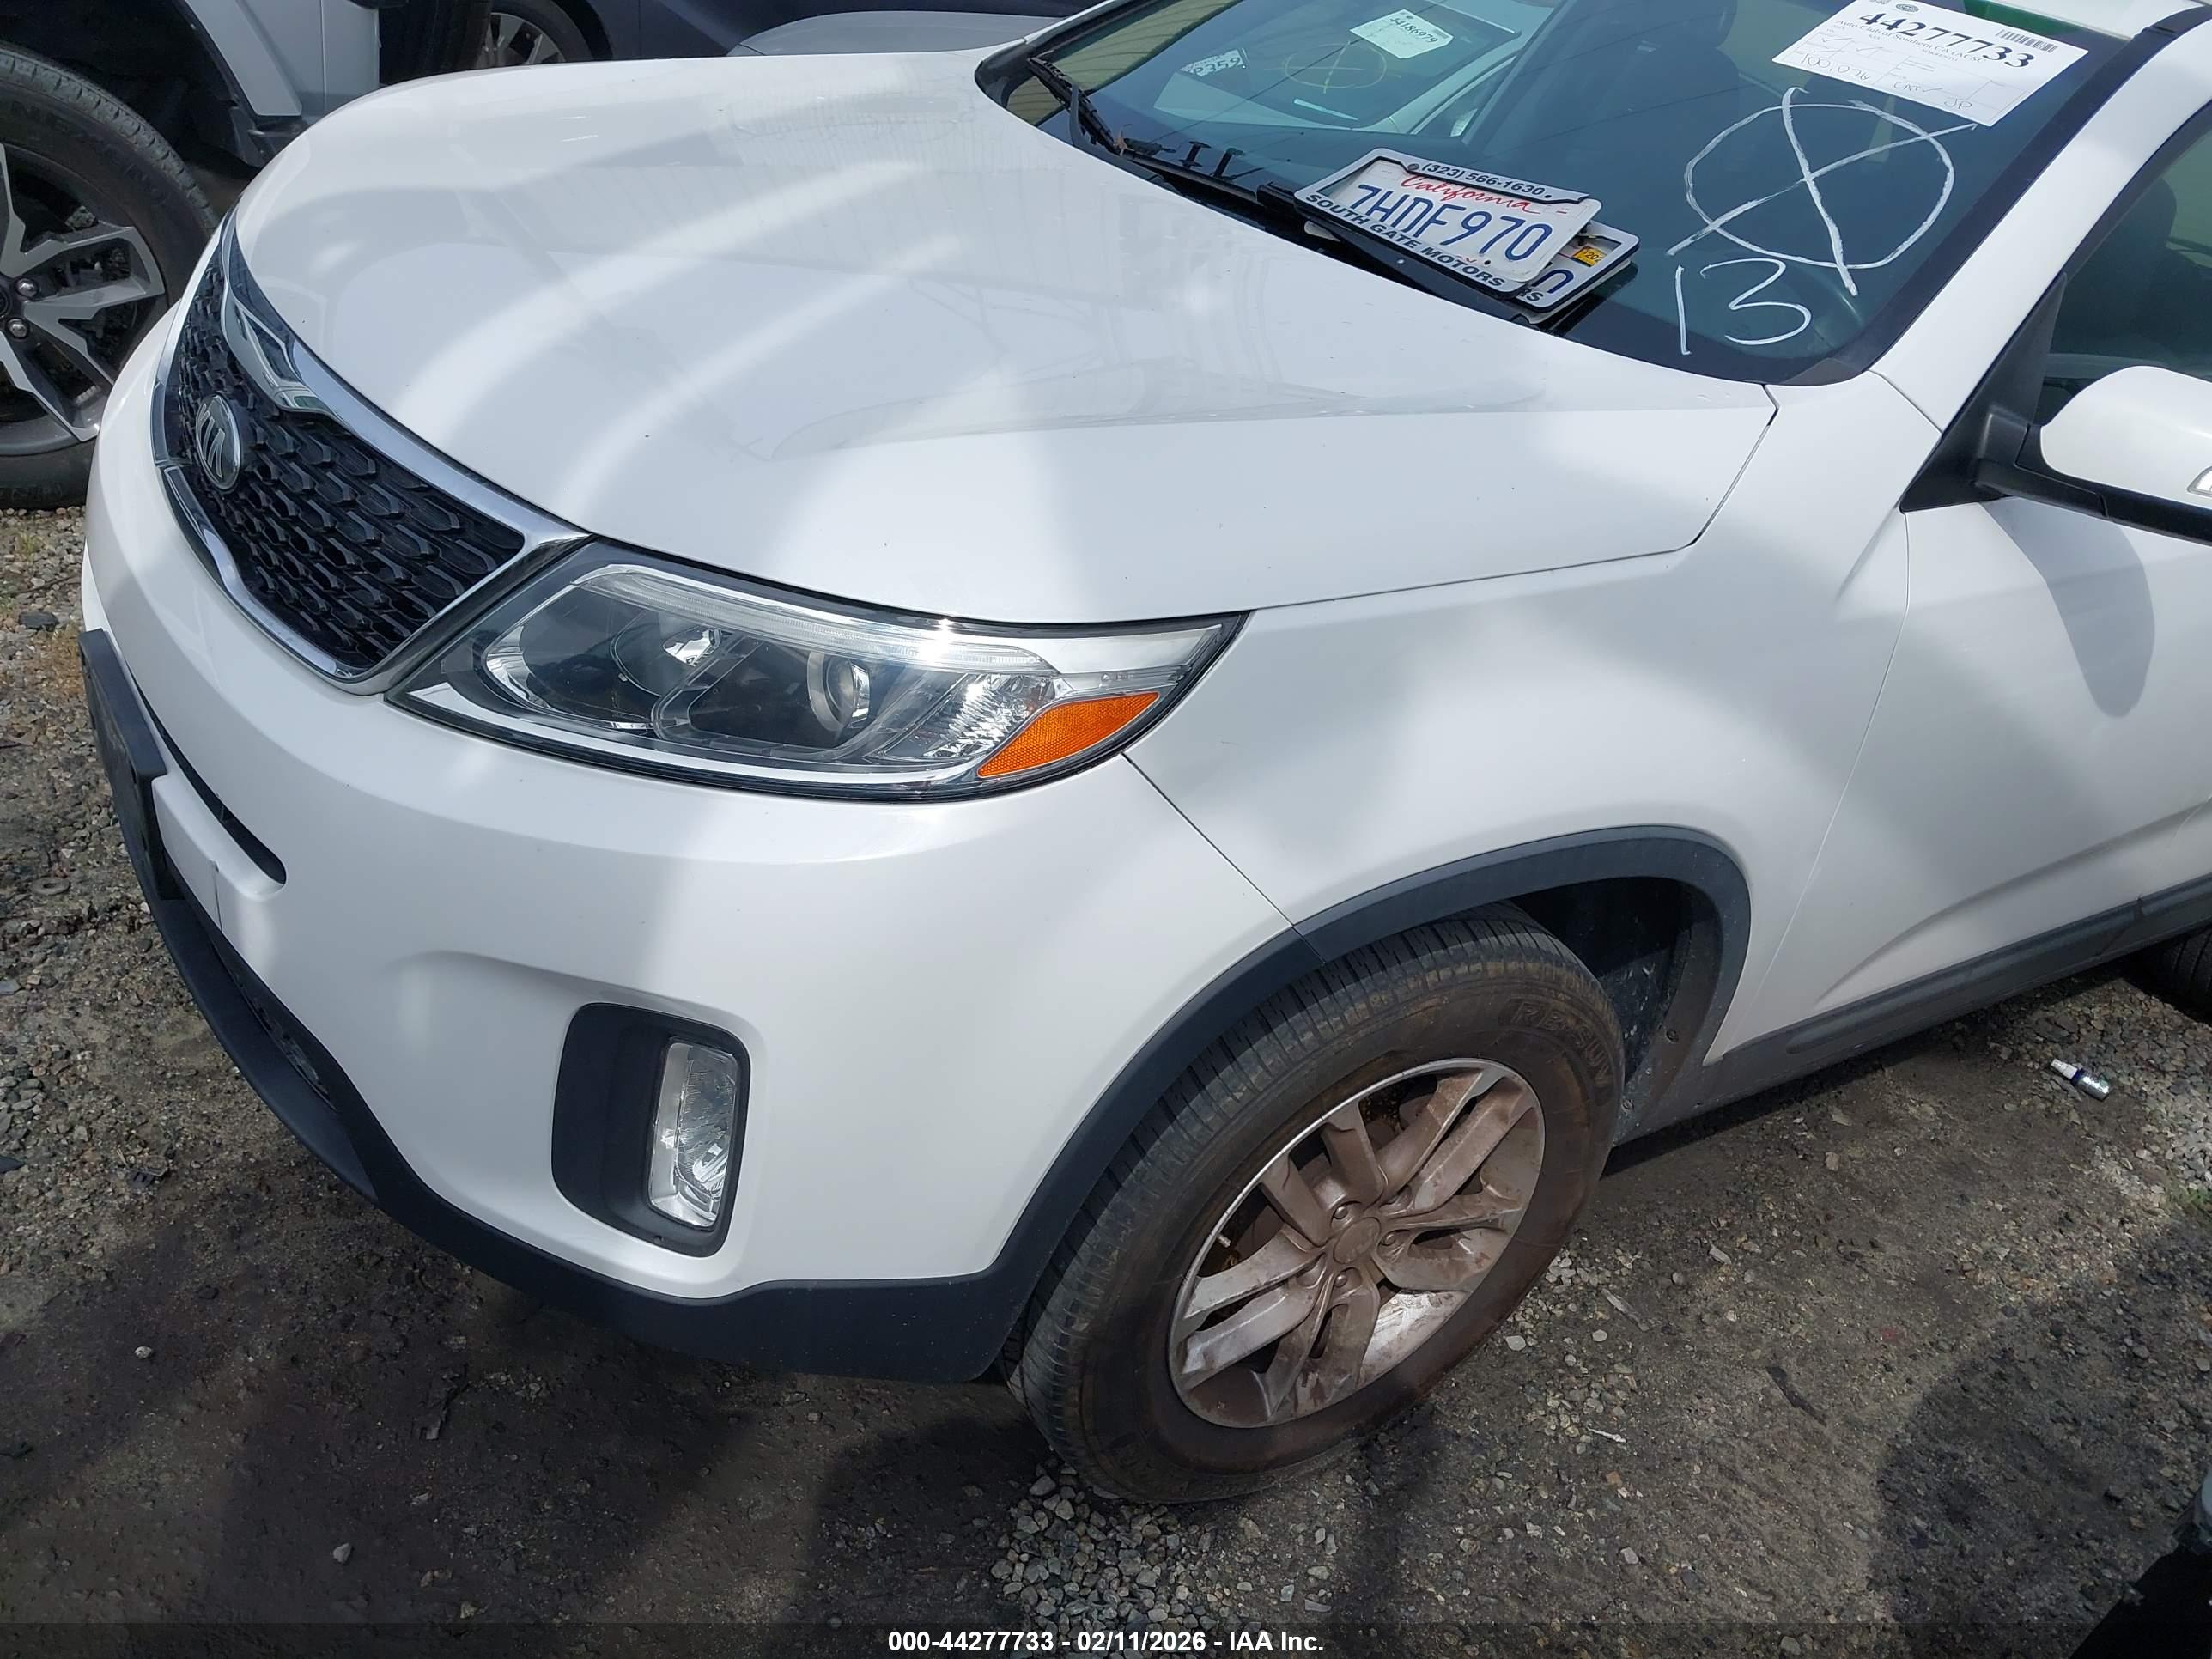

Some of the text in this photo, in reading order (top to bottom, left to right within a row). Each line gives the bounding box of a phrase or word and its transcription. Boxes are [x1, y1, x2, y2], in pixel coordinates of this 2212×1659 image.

[1859, 13, 2034, 67] 44277733
[1860, 25, 1881, 33] Club
[1896, 34, 1932, 48] Southern
[1401, 174, 1540, 214] California
[1422, 162, 1546, 196] (323) 566-1630
[1306, 194, 1370, 225] SOUTH
[1370, 224, 1423, 249] GATE
[1420, 246, 1505, 287] MOTORS
[1351, 184, 1553, 261] 7HDF970
[1675, 258, 1812, 356] 13
